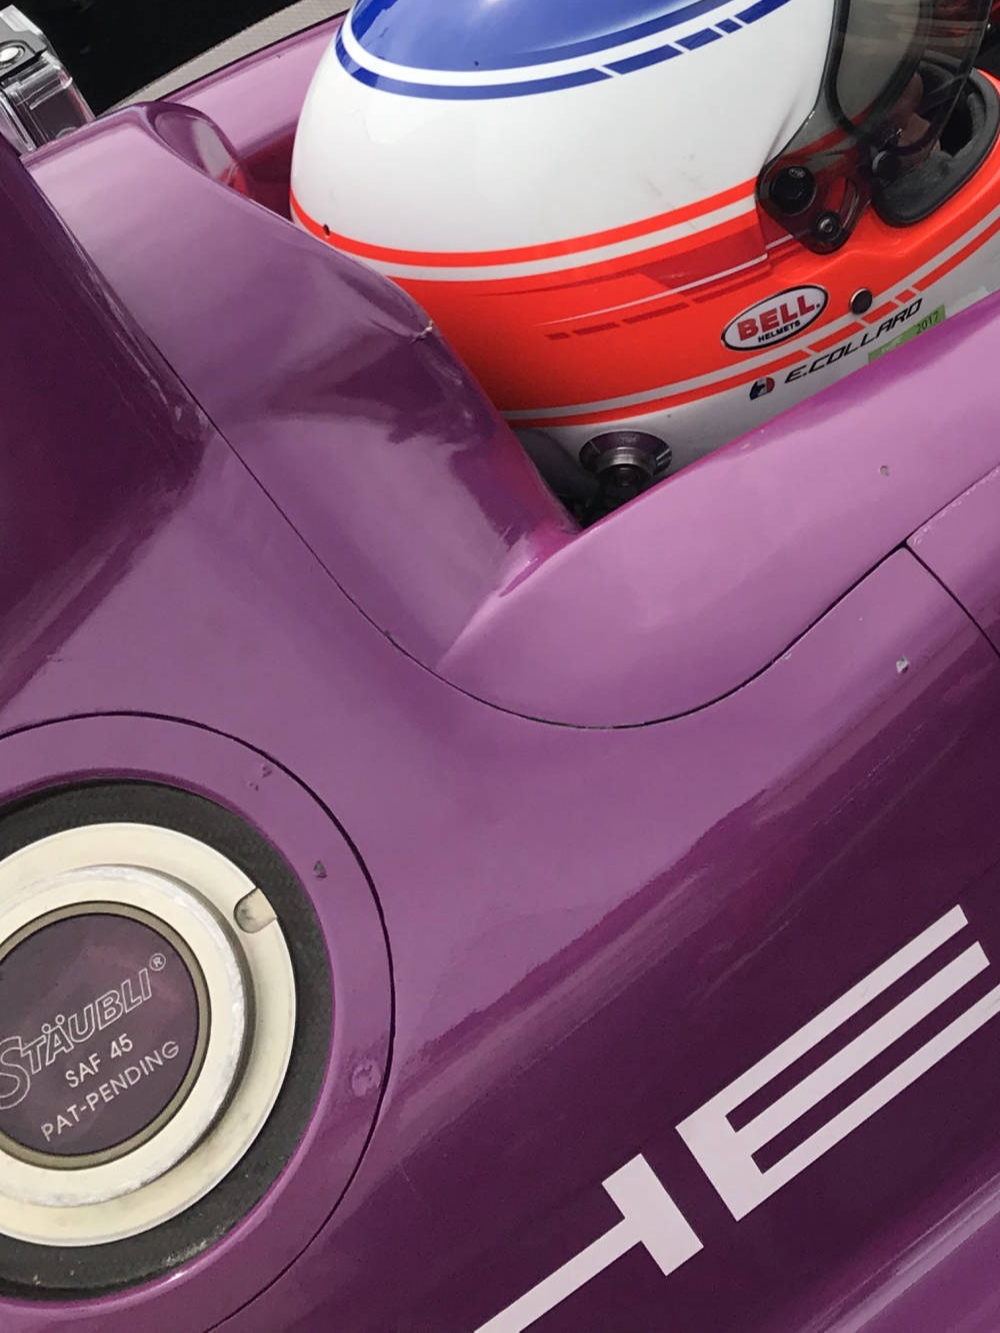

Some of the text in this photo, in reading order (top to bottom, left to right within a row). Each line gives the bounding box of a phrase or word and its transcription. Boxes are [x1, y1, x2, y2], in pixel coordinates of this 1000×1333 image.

[757, 320, 801, 344] HELMETS
[65, 1032, 134, 1089] SAF 45
[41, 1040, 181, 1142] PAT-PENDING
